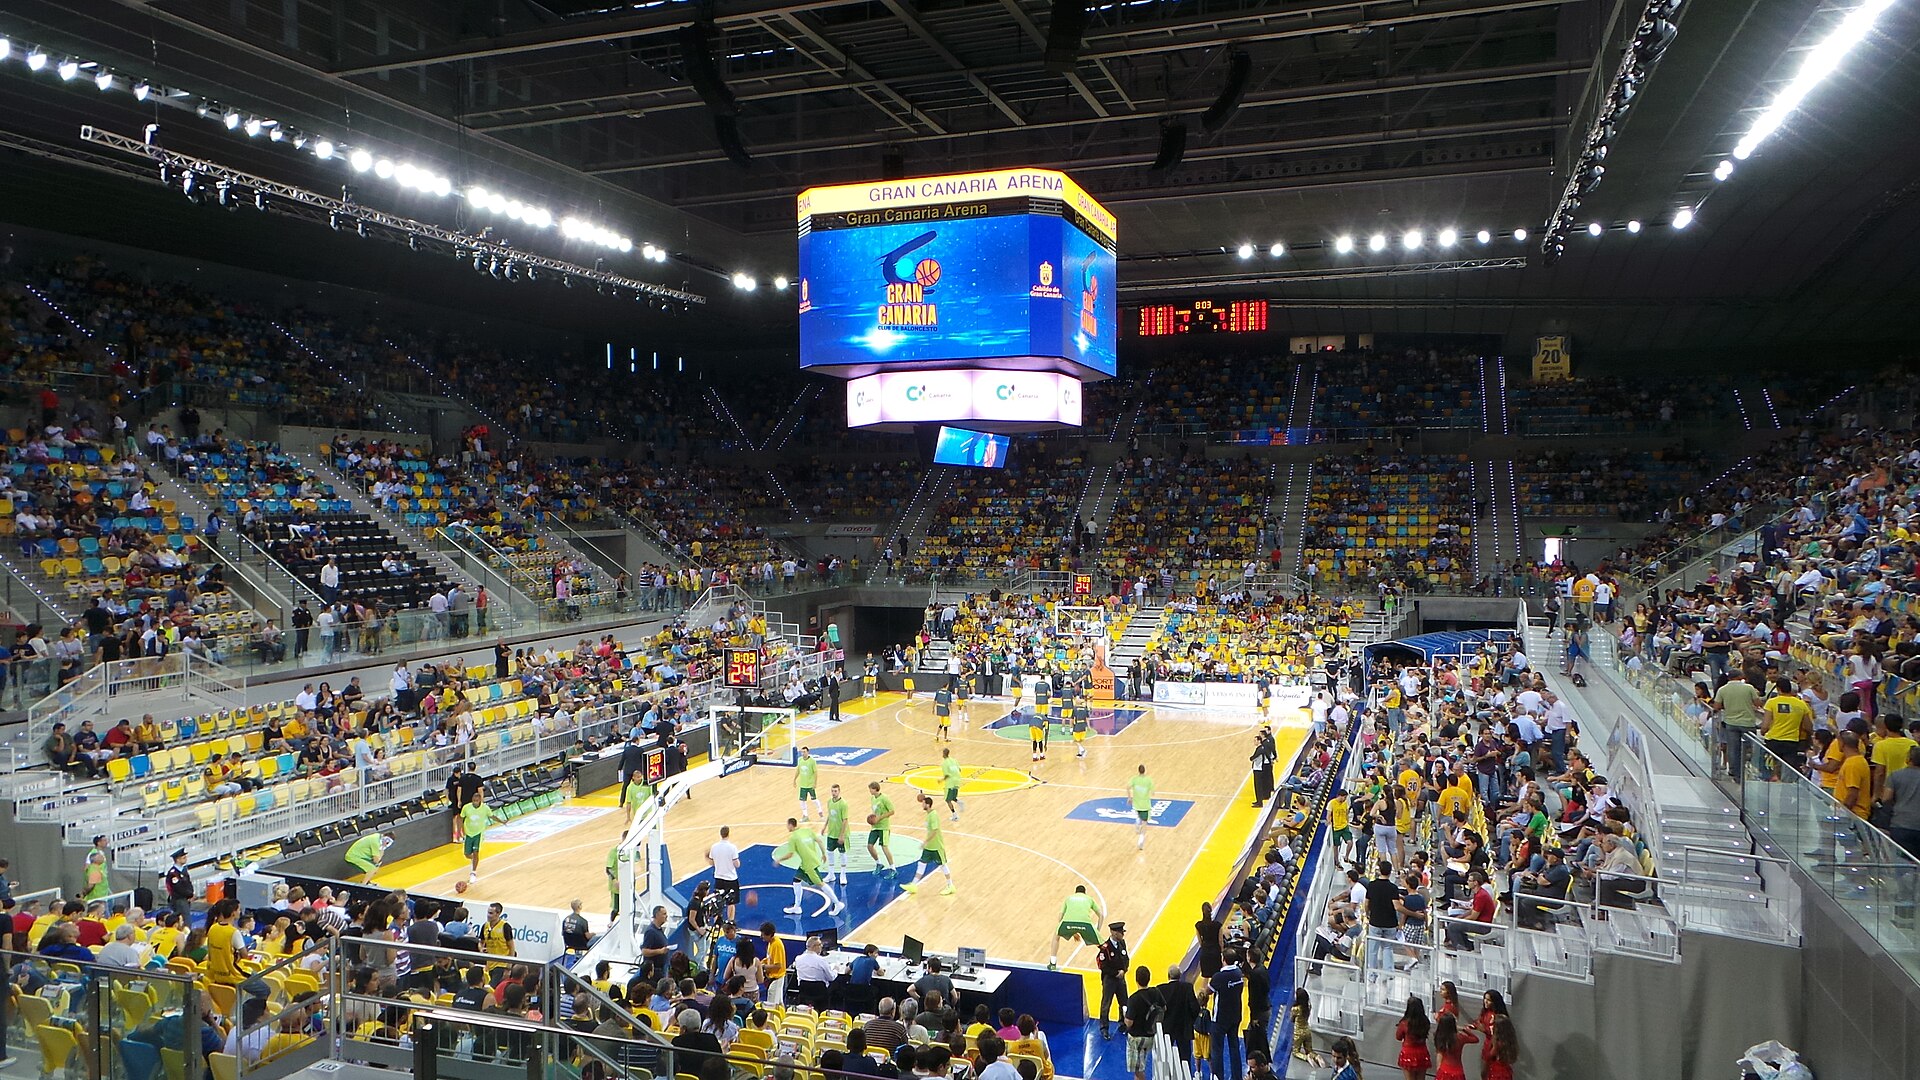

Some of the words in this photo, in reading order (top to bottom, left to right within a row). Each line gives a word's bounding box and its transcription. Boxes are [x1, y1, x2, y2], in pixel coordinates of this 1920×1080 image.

[869, 185, 917, 202] GRAN
[921, 177, 998, 198] CANARIA
[1007, 174, 1064, 192] ARENA
[846, 211, 880, 226] Gran
[884, 205, 940, 222] Canaria
[944, 203, 988, 217] Arena
[887, 282, 923, 304] GRAN
[878, 304, 938, 326] CANARIA
[1541, 349, 1561, 365] 20
[1076, 582, 1089, 593] 24
[733, 652, 756, 664] 8:03
[730, 664, 753, 683] 24
[649, 765, 660, 779] 24
[1407, 781, 1418, 792] 30
[512, 925, 549, 944] ndesa
